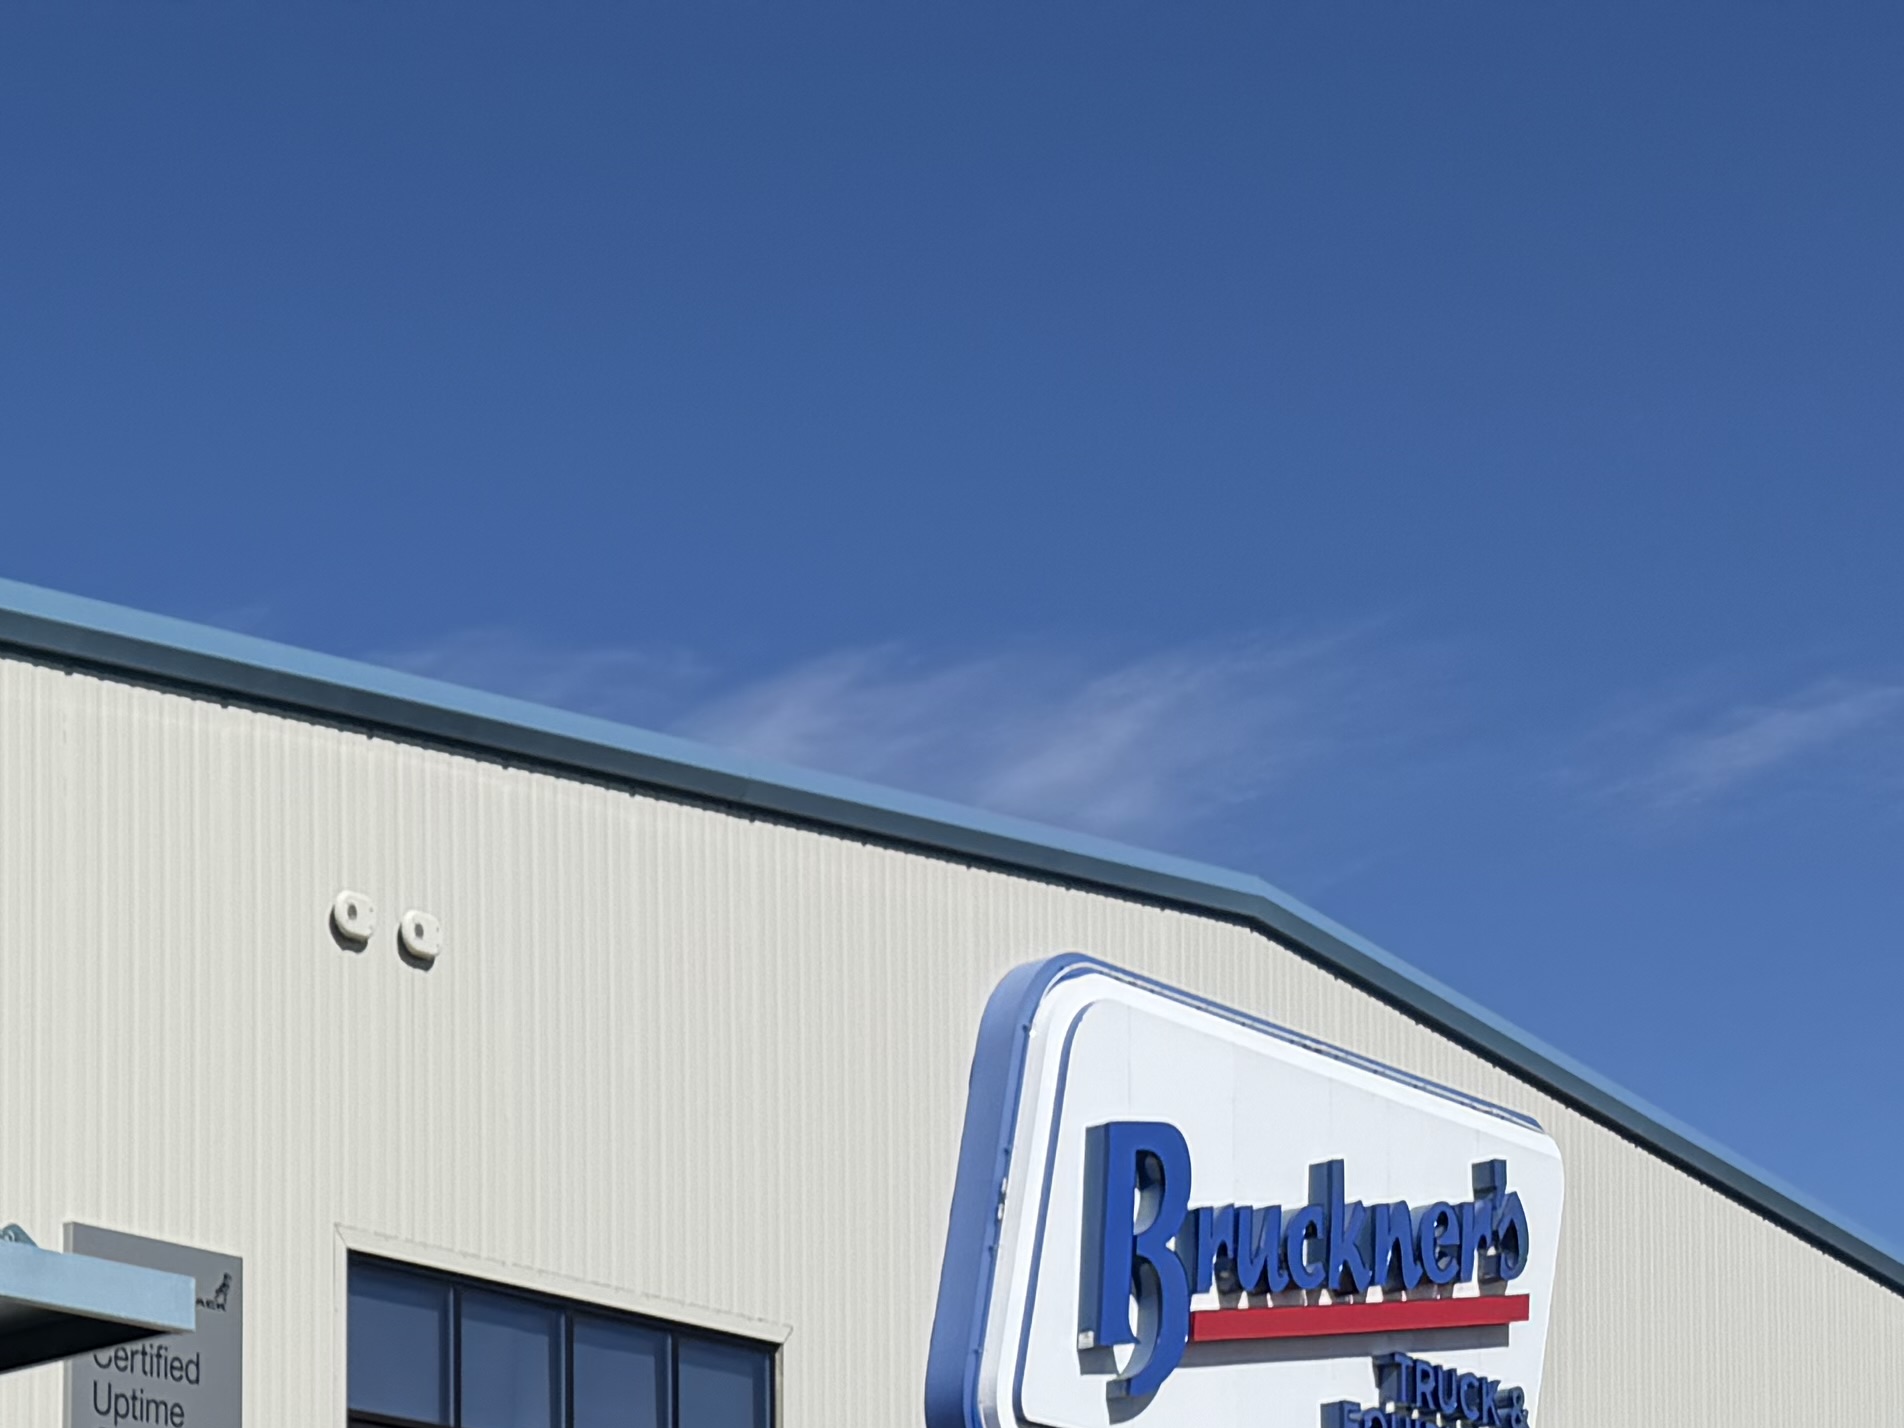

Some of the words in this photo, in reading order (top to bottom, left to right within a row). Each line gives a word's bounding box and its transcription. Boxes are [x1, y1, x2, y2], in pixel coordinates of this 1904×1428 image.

[1078, 1120, 1530, 1402] Bruckner's
[195, 1297, 227, 1313] ACK
[93, 1380, 185, 1428] Uptime
[1384, 1352, 1501, 1428] TRUCK
